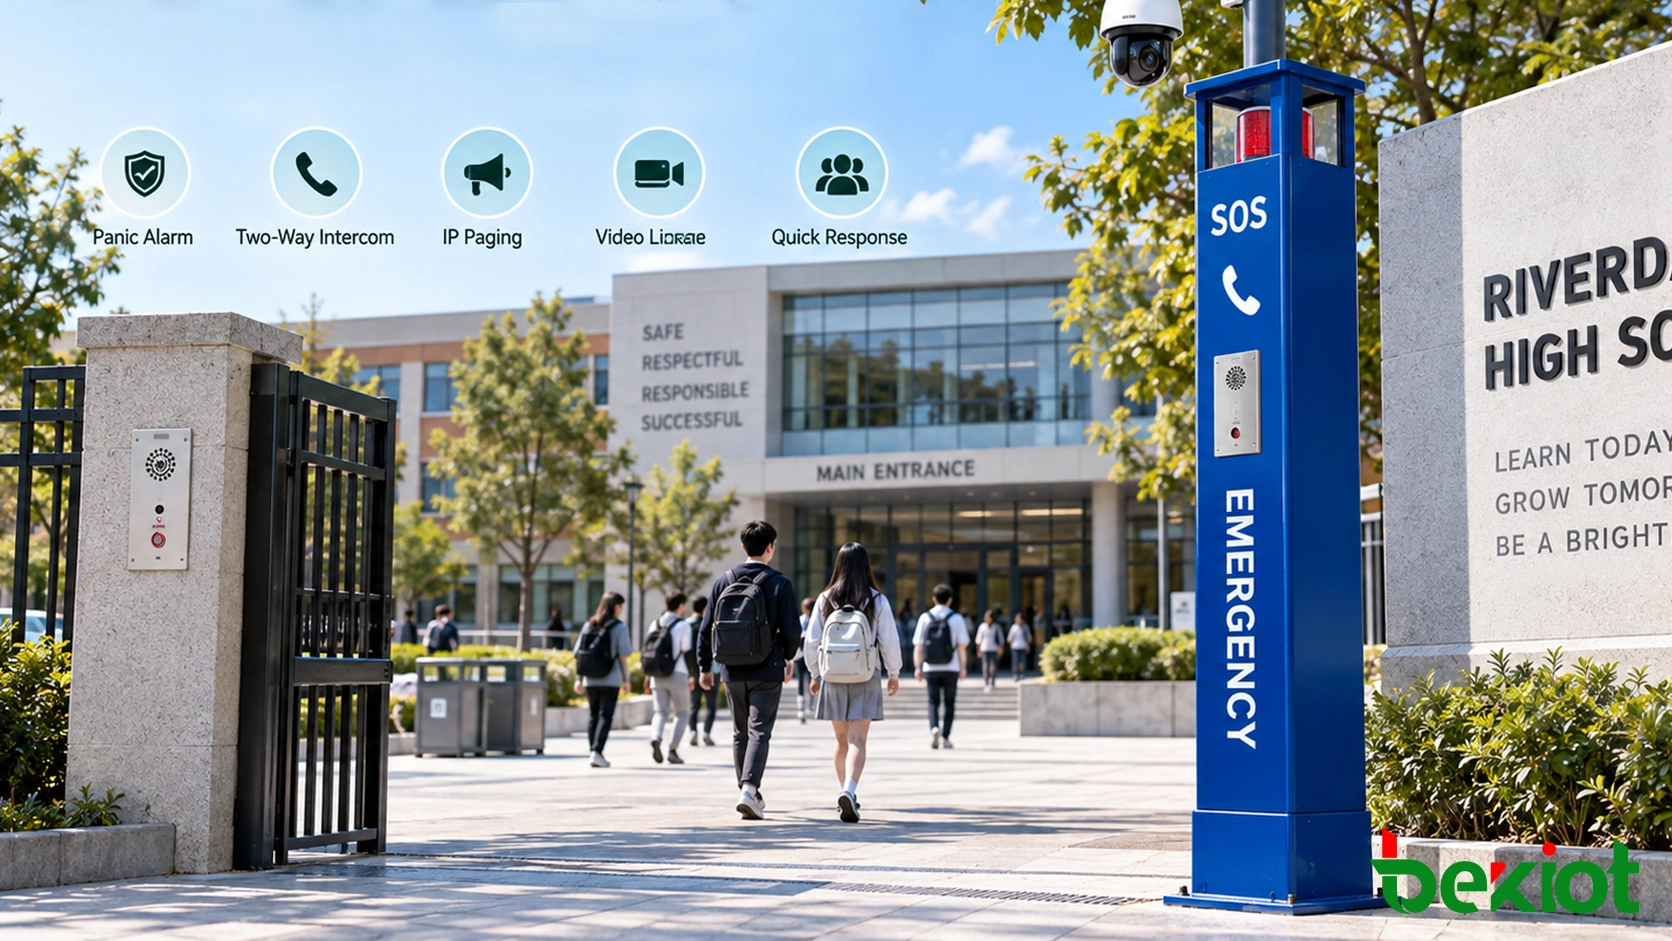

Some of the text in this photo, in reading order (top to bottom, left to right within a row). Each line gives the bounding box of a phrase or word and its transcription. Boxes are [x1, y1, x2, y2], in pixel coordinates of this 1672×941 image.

[1210, 195, 1268, 237] SOS
[1483, 236, 1672, 322] RIVERD
[642, 323, 684, 341] SAFE
[642, 350, 743, 371] RESPECTFUL
[1485, 325, 1598, 391] HIGH
[642, 381, 749, 403] RESPONSIBLE
[641, 411, 743, 431] SUCCESSFUL
[817, 459, 975, 482] MAIN ENTRANCE
[1495, 442, 1571, 473] LEARN
[1495, 486, 1571, 515] GROW
[1496, 522, 1669, 557] BE A BRIGHT
[1225, 488, 1257, 750] EMERGENCY
